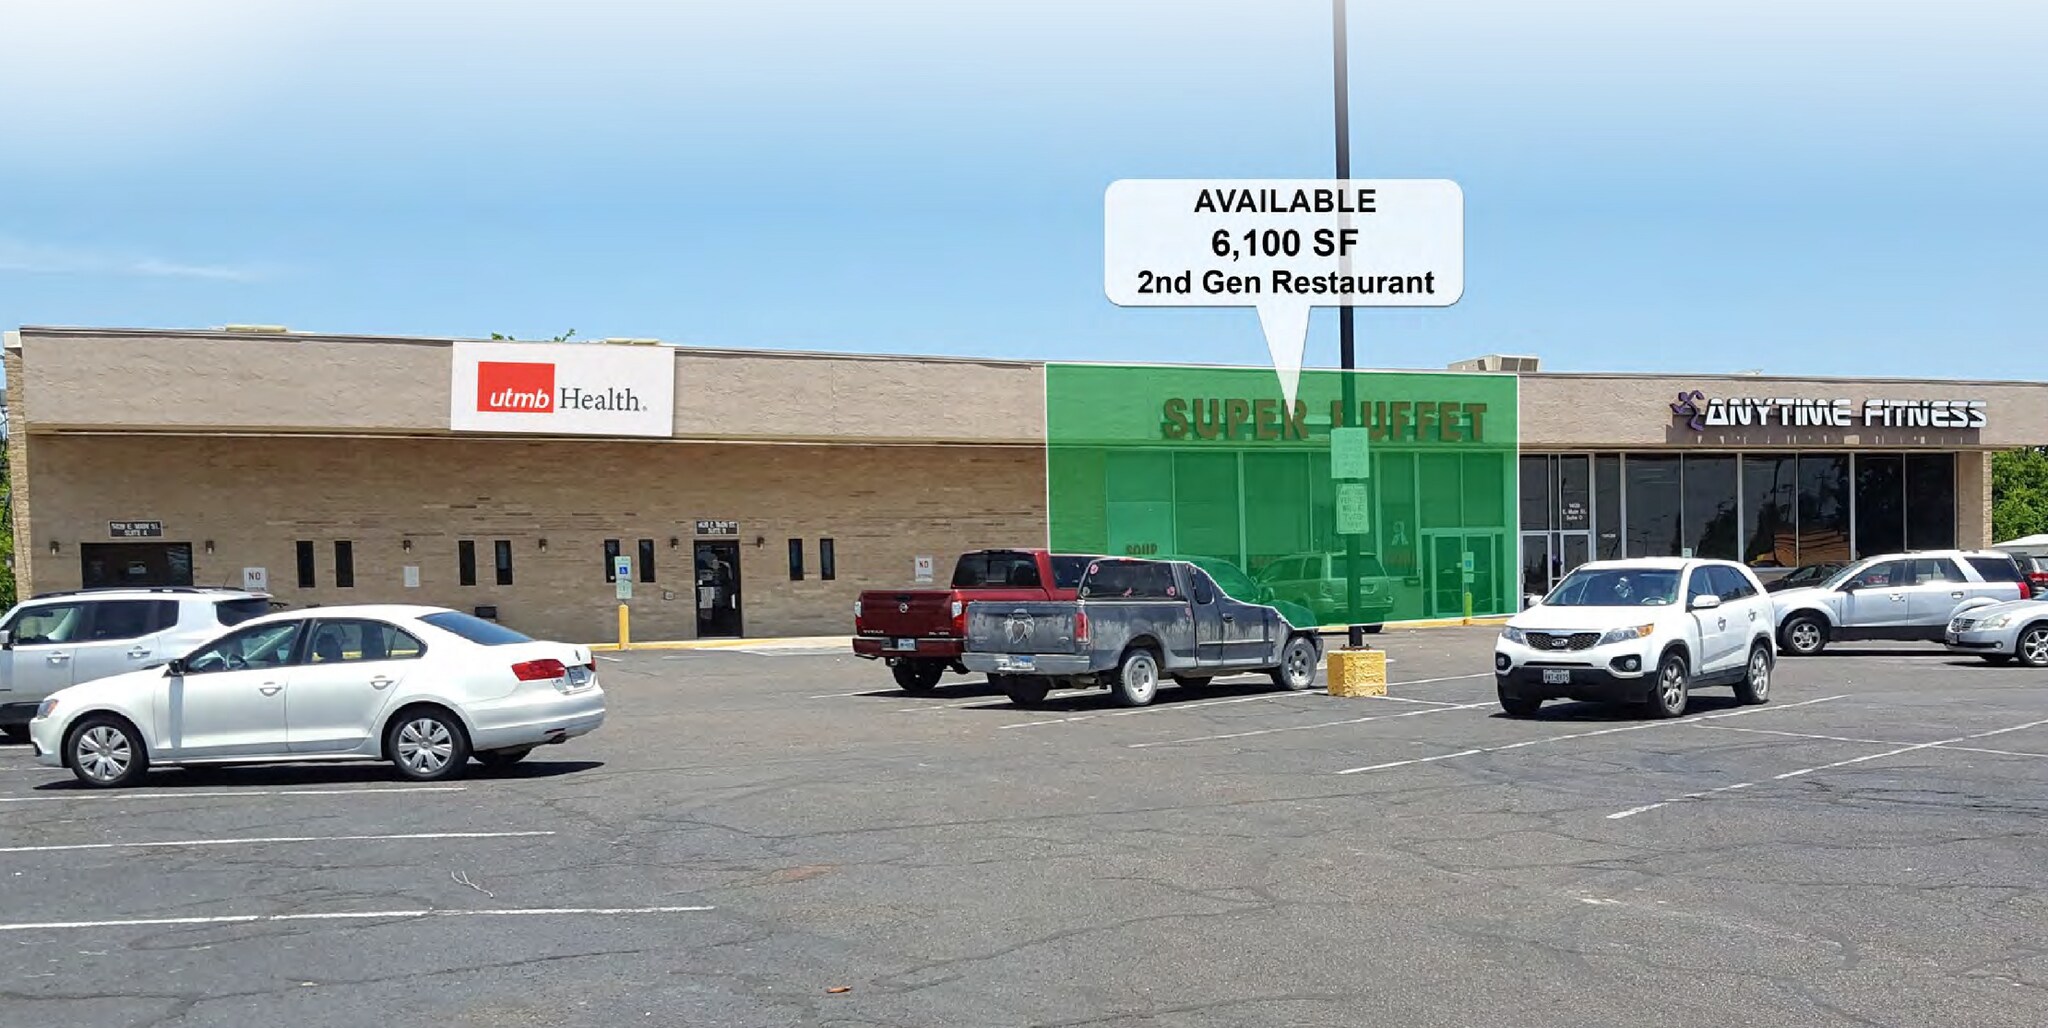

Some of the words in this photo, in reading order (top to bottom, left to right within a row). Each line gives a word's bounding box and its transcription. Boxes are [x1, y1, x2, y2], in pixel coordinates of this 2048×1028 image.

[490, 387, 549, 409] utmb
[559, 387, 641, 412] Health
[1162, 397, 1310, 441] SUPER
[1704, 397, 1852, 427] ANYTIME
[1864, 399, 1987, 428] FITNESS
[1125, 543, 1158, 555] SOUP
[919, 560, 929, 568] NO
[248, 571, 261, 581] NO
